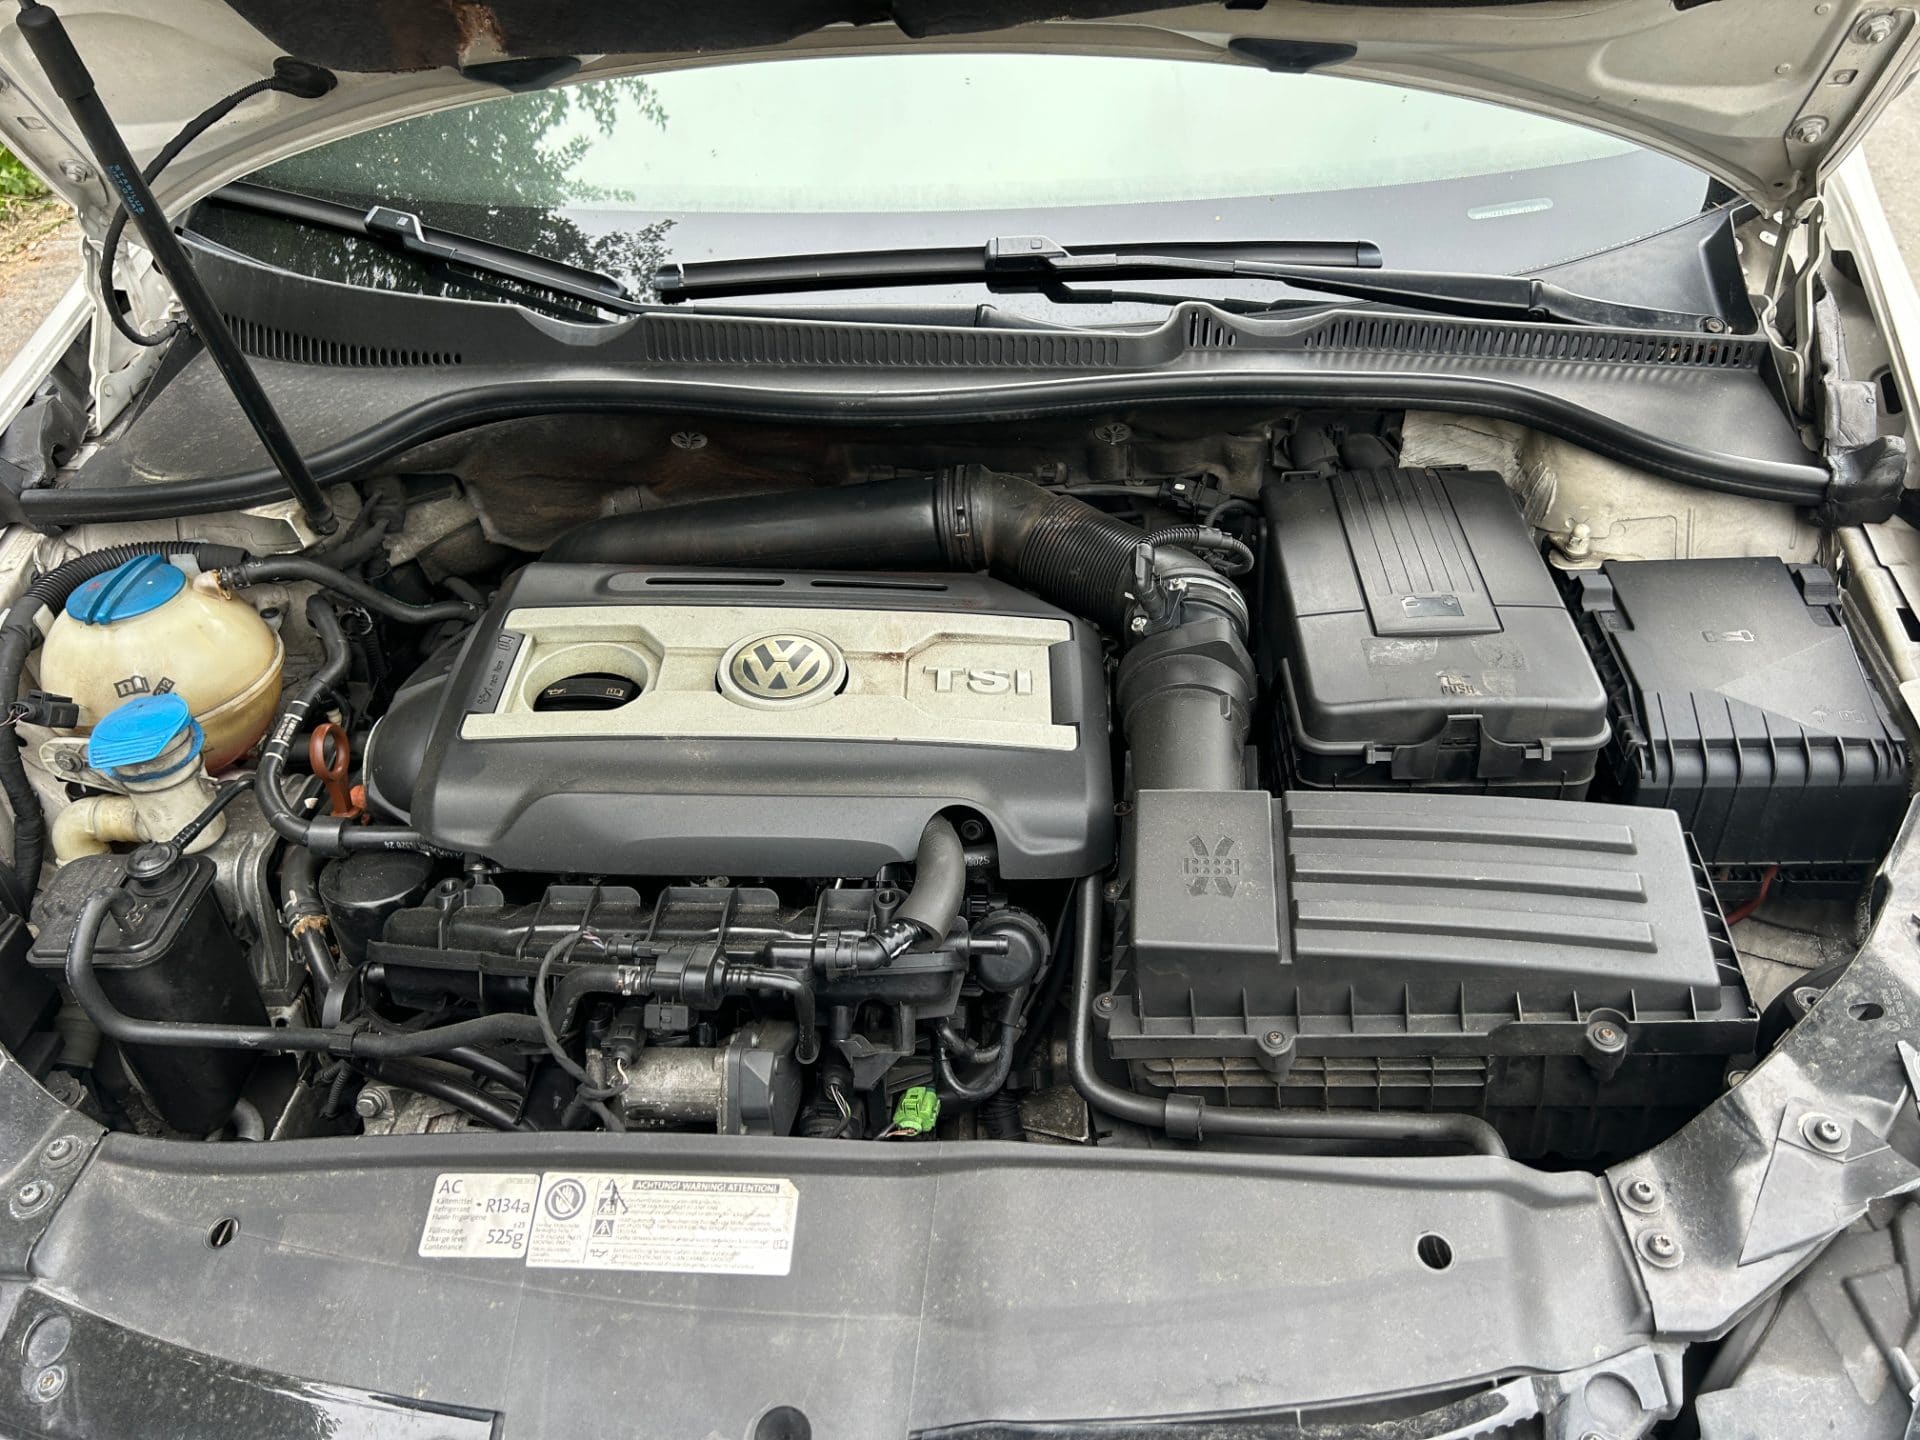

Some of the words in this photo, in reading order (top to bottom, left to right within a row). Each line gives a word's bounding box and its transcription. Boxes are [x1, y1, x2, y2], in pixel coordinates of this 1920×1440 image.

[923, 664, 1034, 696] TSI
[1441, 684, 1476, 695] PUSH
[438, 1179, 463, 1194] AC
[636, 1180, 680, 1191] ACHTUNG!
[682, 1181, 726, 1192] WARNING!
[727, 1183, 778, 1193] ATTENTION!
[485, 1198, 531, 1214] R134a
[486, 1229, 524, 1249] 525g
